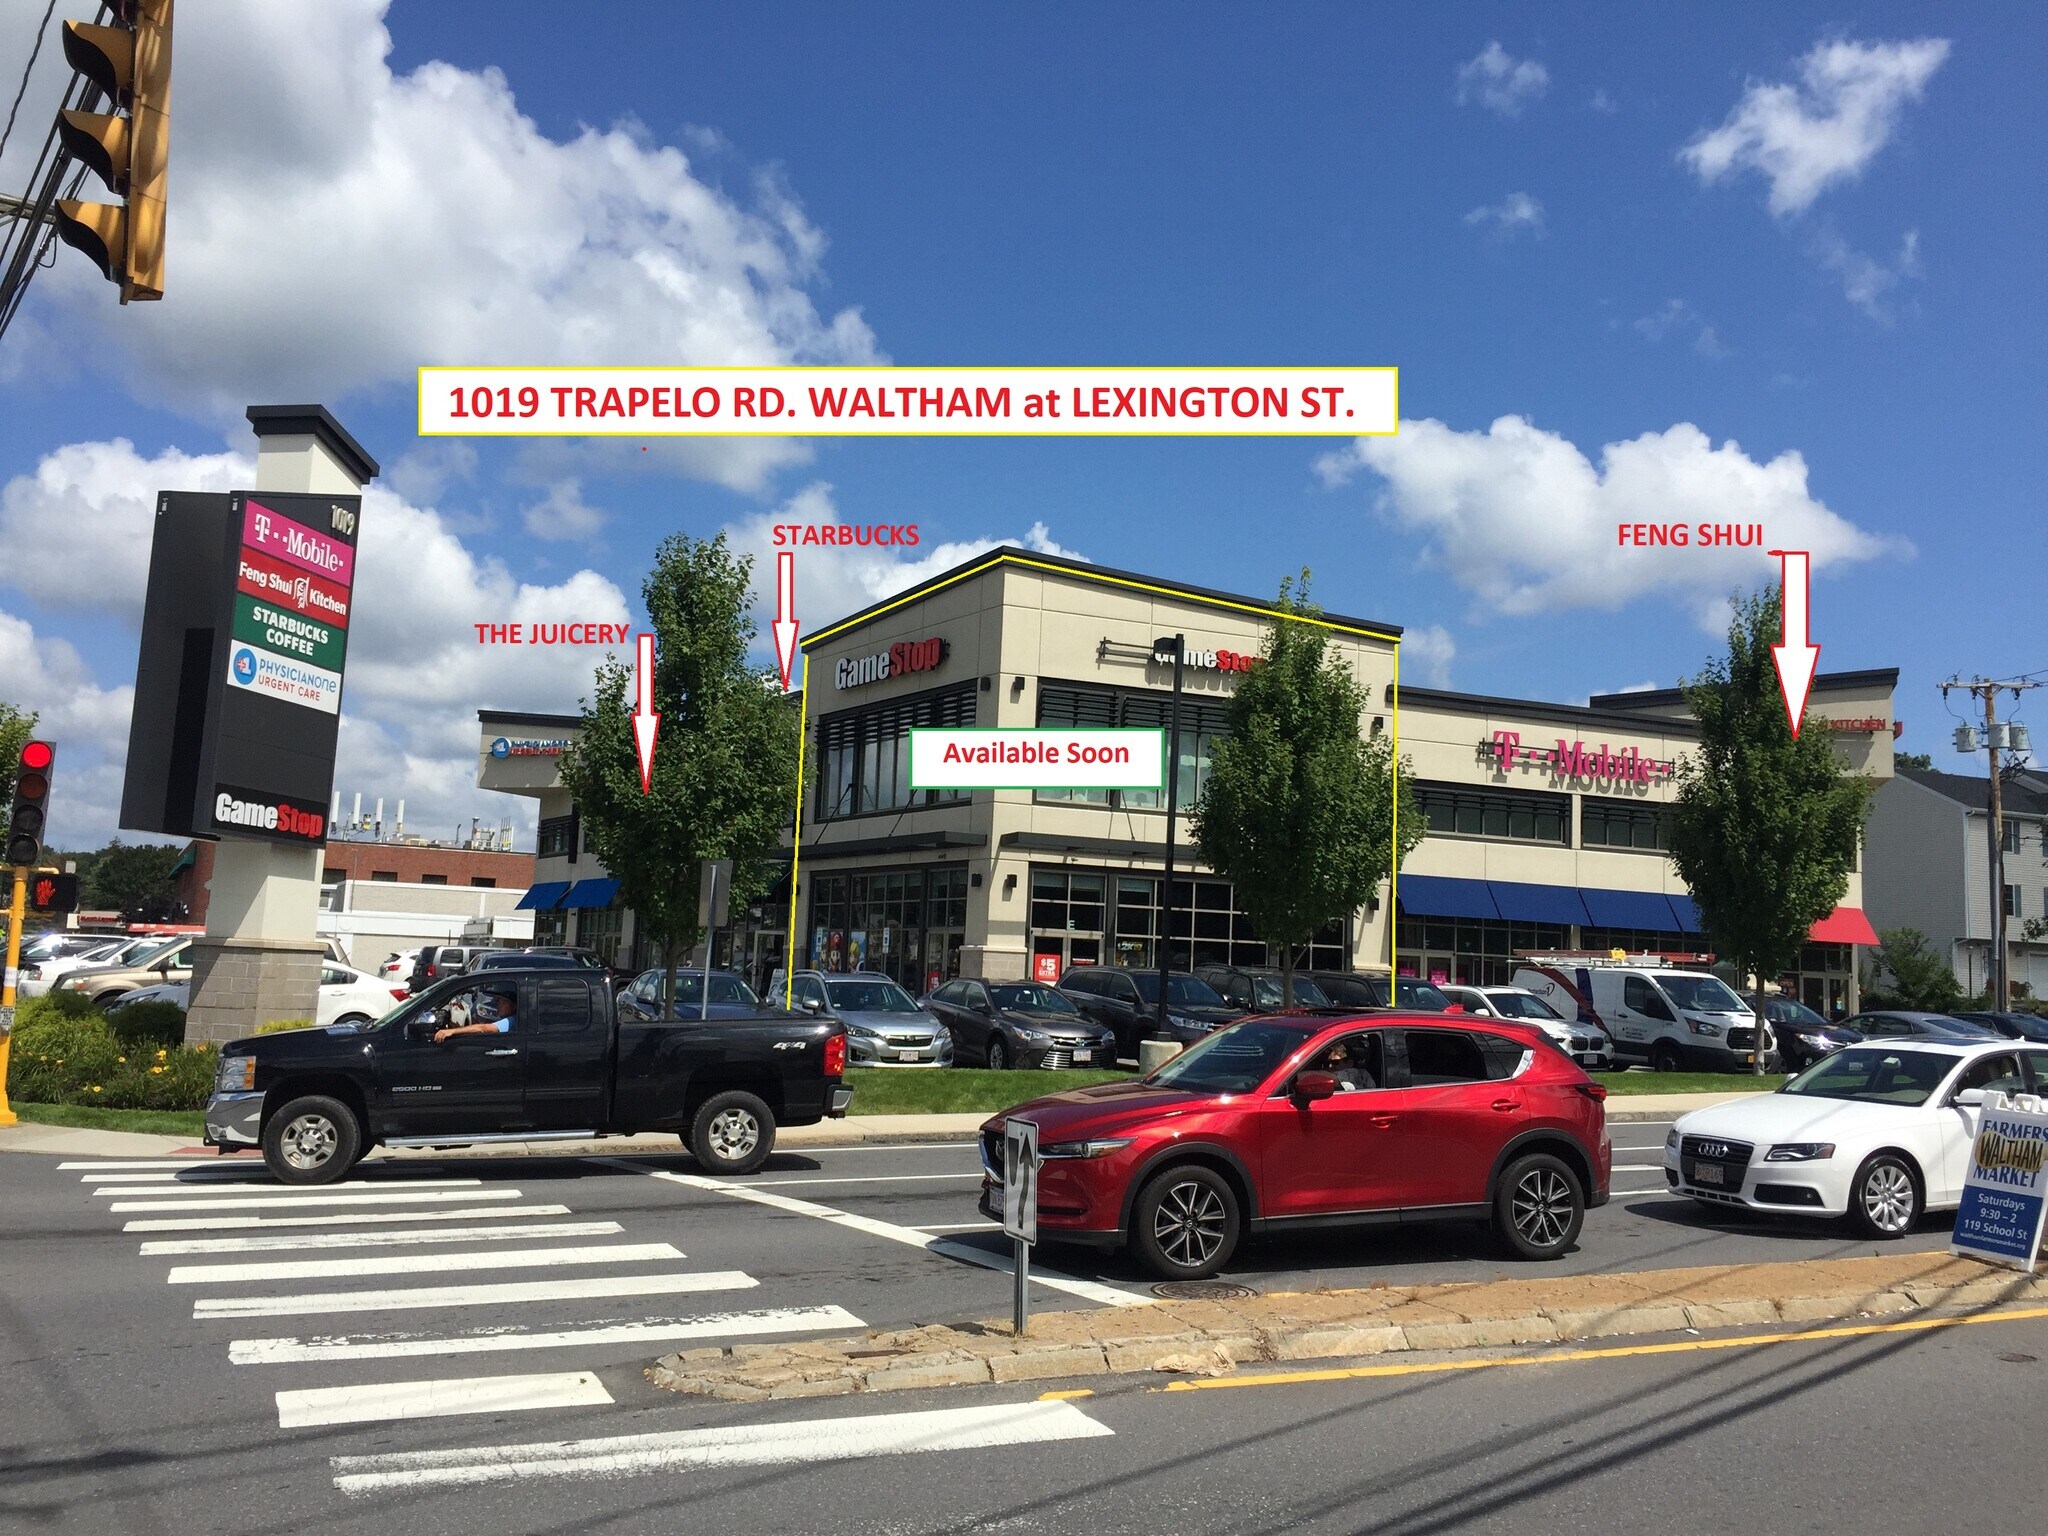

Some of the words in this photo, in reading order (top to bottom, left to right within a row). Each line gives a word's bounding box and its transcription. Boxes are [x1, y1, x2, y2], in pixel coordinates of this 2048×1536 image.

[331, 504, 355, 535] 1019
[239, 561, 267, 588] Feng
[268, 573, 293, 595] Shui
[309, 588, 346, 616] Kitchen
[252, 606, 329, 644] STARBUCKS
[265, 628, 314, 656] COFFEE
[835, 637, 941, 690] GameStop
[258, 675, 295, 694] URGENT
[297, 685, 321, 702] CARE
[215, 793, 323, 838] GameStop
[1980, 1133, 2044, 1170] WALTHAM
[1978, 1193, 2026, 1211] Saturdays
[1980, 1207, 2001, 1220] 9:30
[2010, 1213, 2017, 1223] 2
[1964, 1219, 1981, 1231] 119
[1983, 1222, 2016, 1238] School
[2016, 1229, 2028, 1240] St
